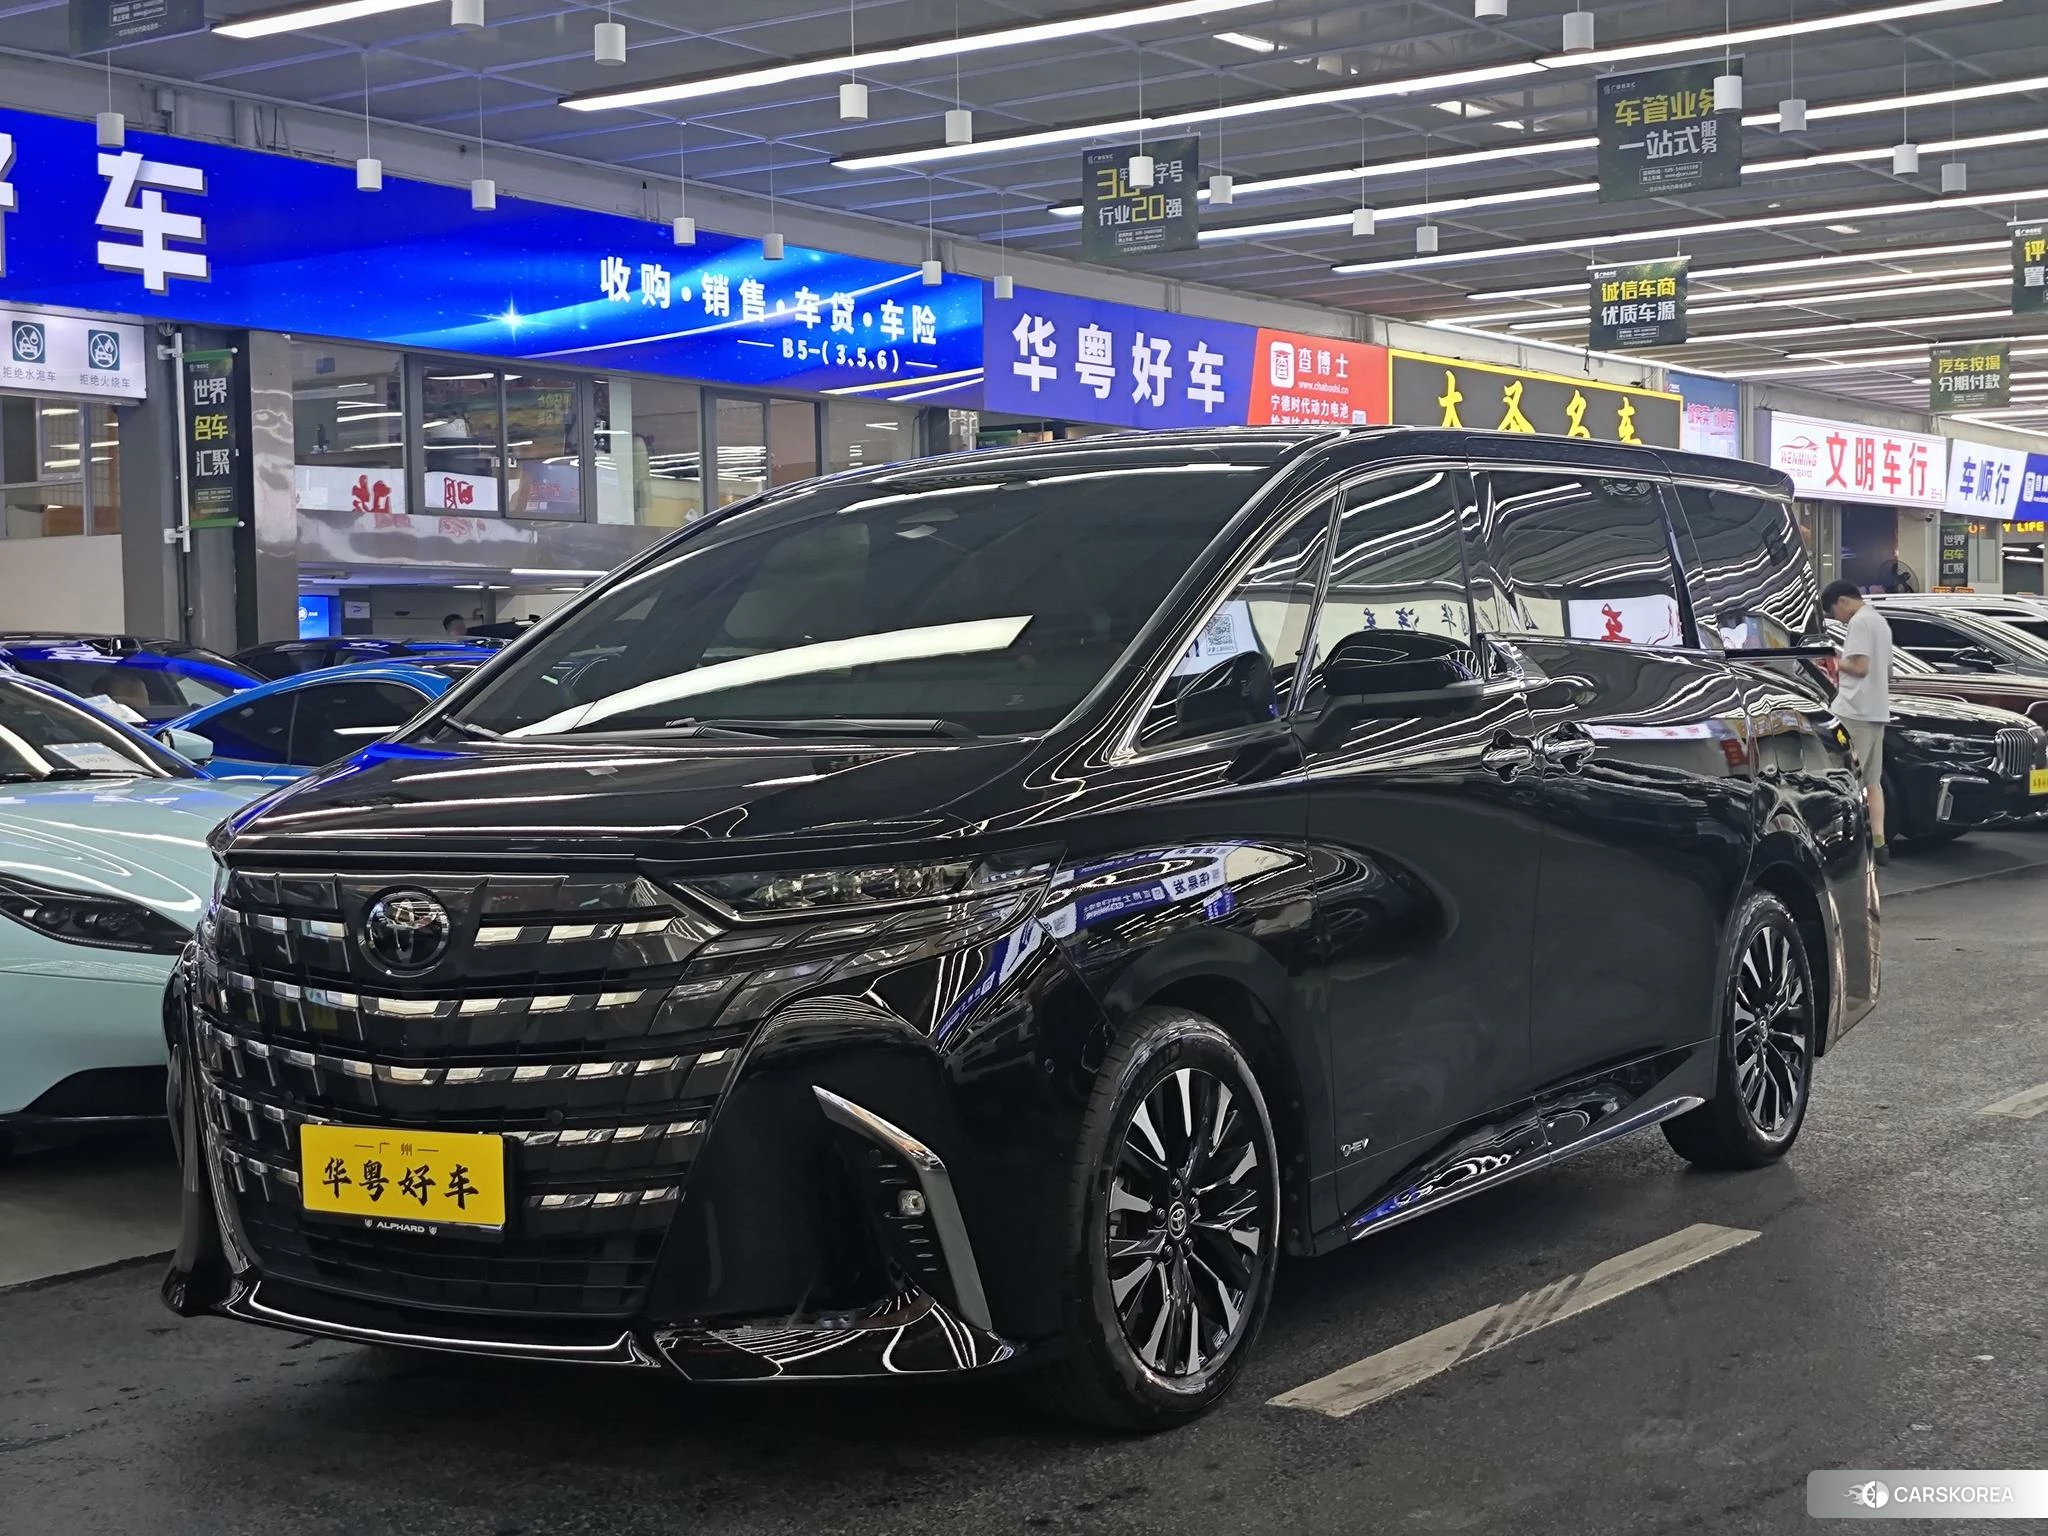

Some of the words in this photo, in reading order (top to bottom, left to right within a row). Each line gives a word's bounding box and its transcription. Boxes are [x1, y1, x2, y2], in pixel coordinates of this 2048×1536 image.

[1614, 88, 1714, 127] 车管业务
[1619, 120, 1717, 160] 一站式服务
[1099, 194, 1182, 227] 行业20强
[2024, 239, 2048, 263] 评
[1601, 277, 1676, 302] 诚信车商
[2024, 266, 2048, 288] 置
[1601, 300, 1676, 326] 优质车源
[2, 366, 57, 383] 拒绝水泡车
[1012, 312, 1225, 414] 华粤好车
[1298, 347, 1349, 378] 查博士
[1938, 354, 2001, 374] 汽车按揭
[79, 374, 131, 389] 拒绝火烧车
[193, 377, 228, 406] 世界
[1938, 374, 2001, 393] 分期付款
[1271, 394, 1349, 419] 宁德时代动力电池
[195, 414, 229, 441] 名车
[196, 448, 230, 477] 汇聚
[1826, 432, 1928, 497] 文明车行
[1960, 456, 2010, 505] 车顺行
[2017, 521, 2045, 533] LIFE
[379, 1141, 413, 1157] 广州
[322, 1157, 479, 1210] 华粤好车
[376, 1221, 425, 1234] ALPHARD
